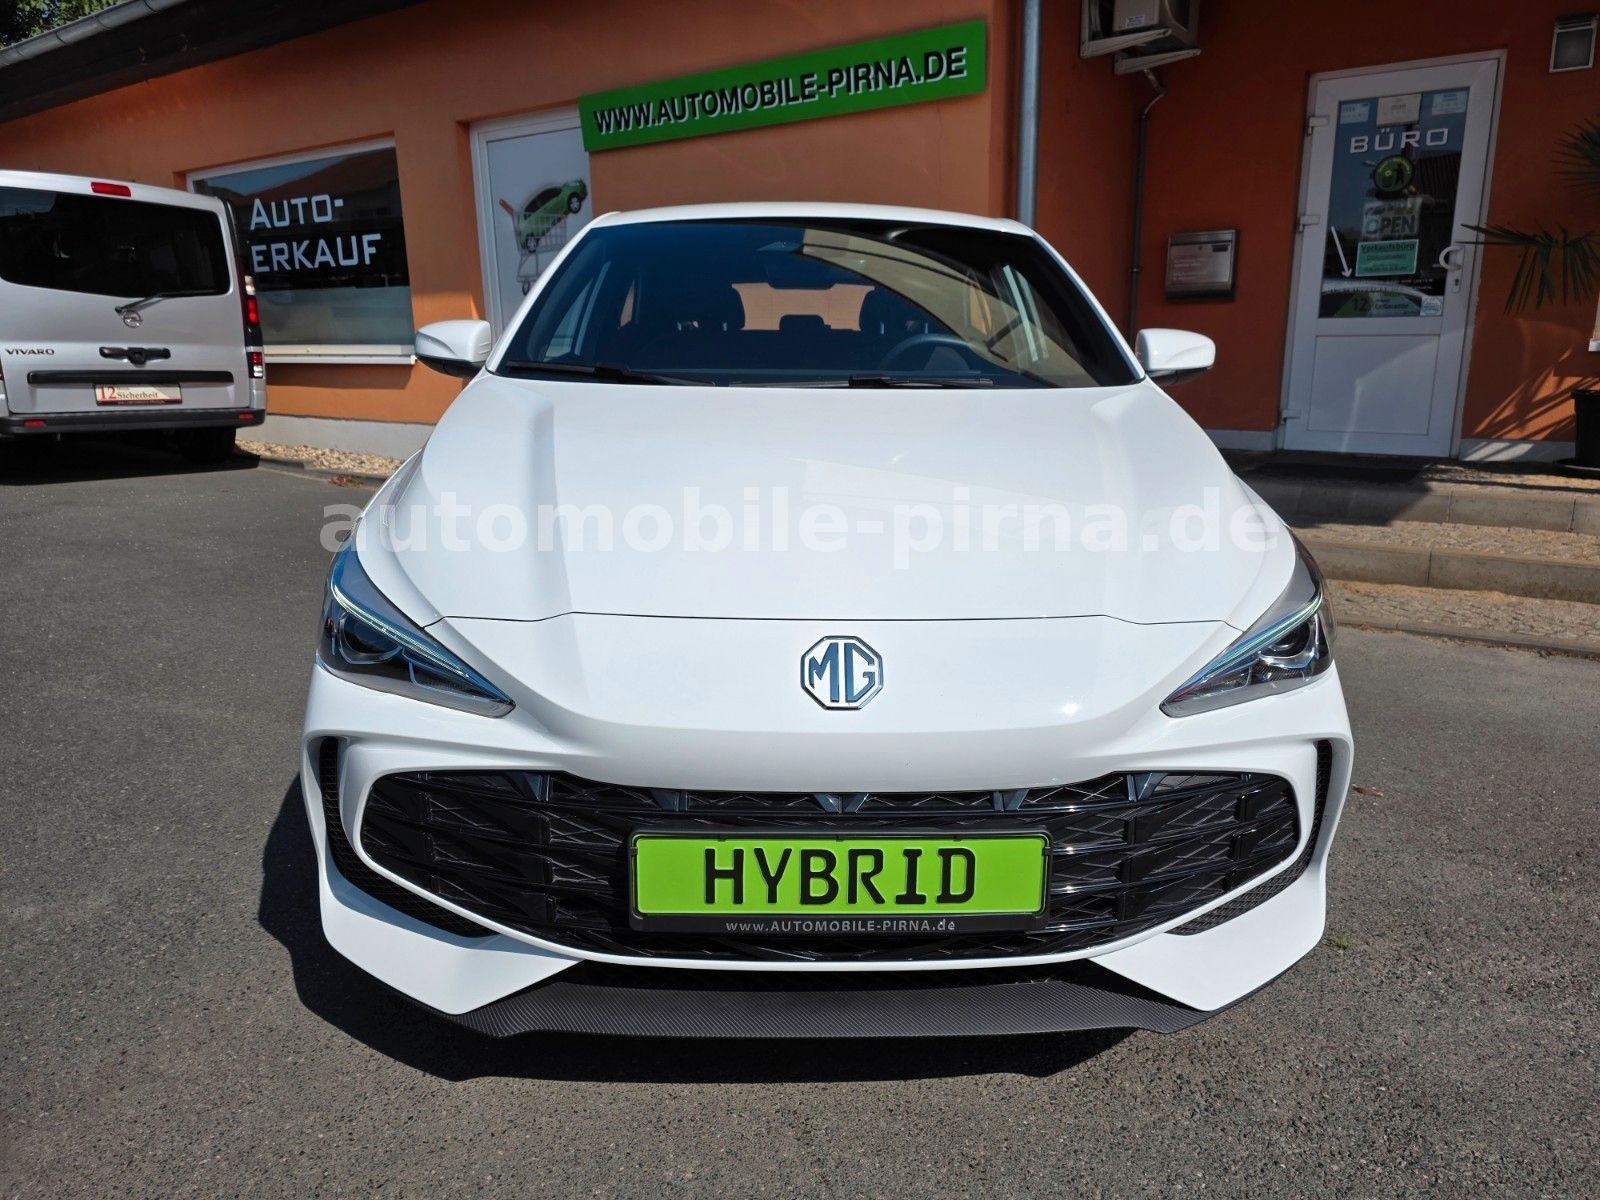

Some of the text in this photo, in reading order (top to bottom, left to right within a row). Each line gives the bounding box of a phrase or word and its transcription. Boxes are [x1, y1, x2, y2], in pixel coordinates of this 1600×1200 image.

[594, 46, 967, 135] WWW.AUTOMOBILE-PIRNA.DE
[1351, 128, 1449, 153] BÜRO
[249, 194, 344, 230] AUTO-
[250, 233, 382, 273] ERKAUF
[5, 347, 56, 356] VIVARO
[100, 385, 159, 400] 12 Sicherheit
[808, 642, 875, 703] MG
[704, 847, 976, 905] HYBRID
